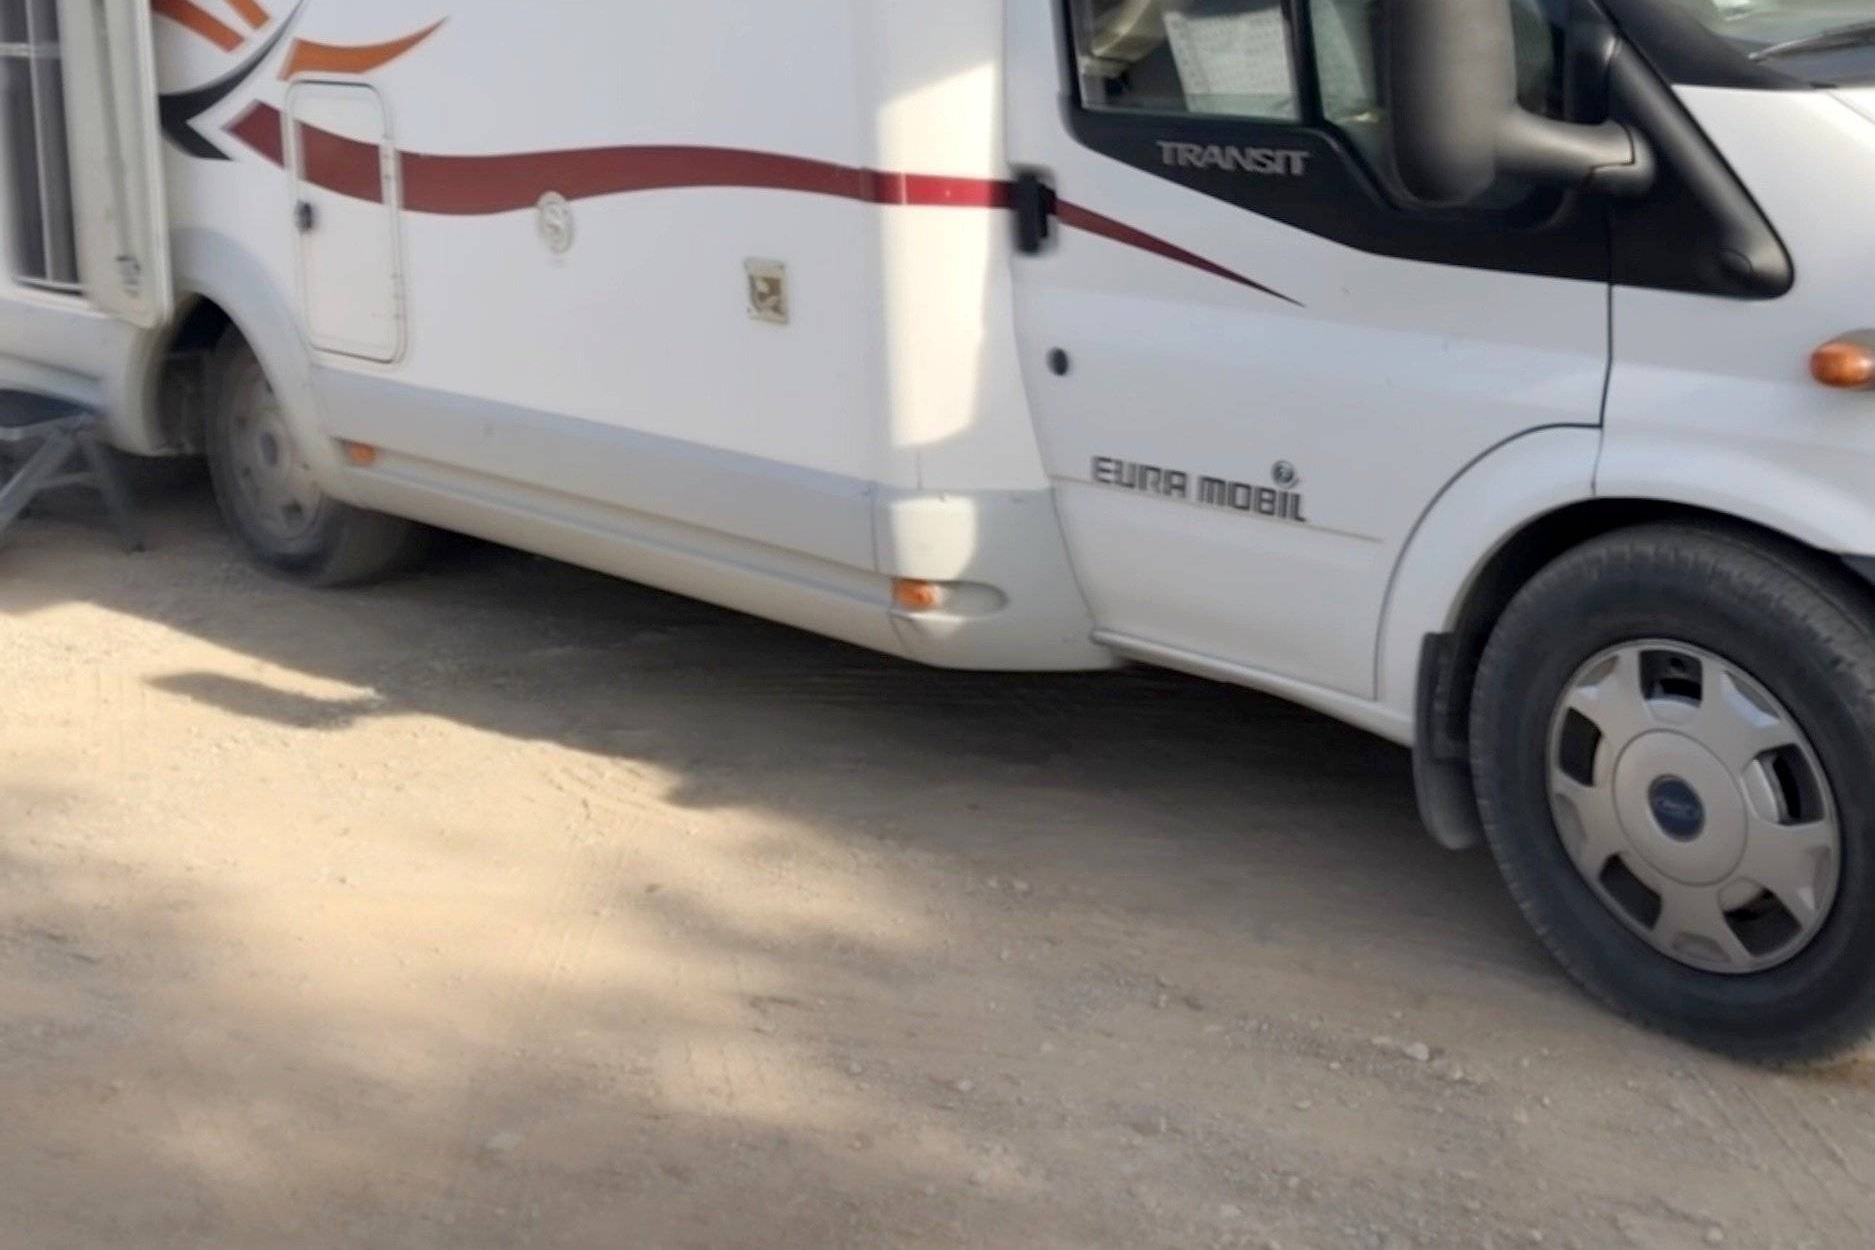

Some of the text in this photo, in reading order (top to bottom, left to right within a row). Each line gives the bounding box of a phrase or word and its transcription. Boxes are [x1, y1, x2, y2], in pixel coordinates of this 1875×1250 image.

[1156, 140, 1310, 176] TRANSIT
[1093, 456, 1307, 522] EURA MOBIL
